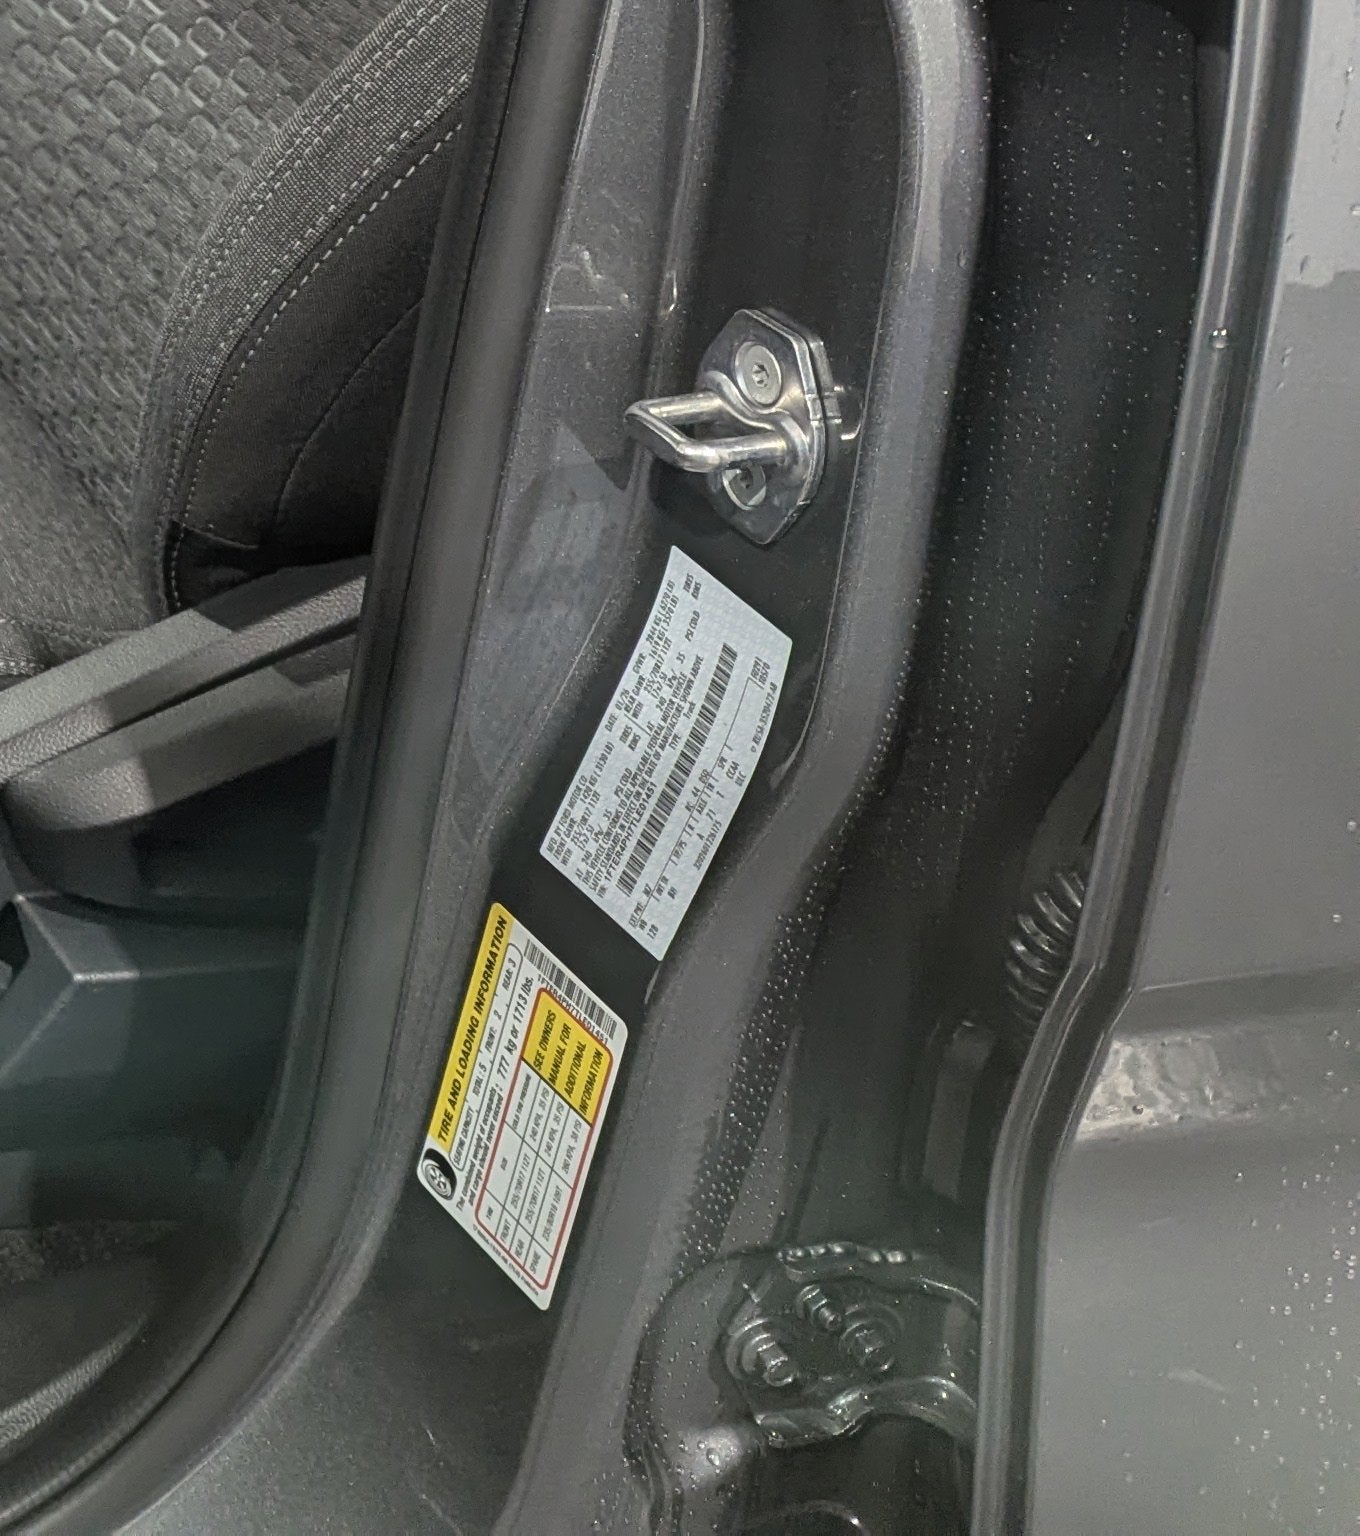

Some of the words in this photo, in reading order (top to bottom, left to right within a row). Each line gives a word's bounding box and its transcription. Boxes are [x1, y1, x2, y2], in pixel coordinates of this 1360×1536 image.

[669, 669, 687, 700] VEHICLE
[659, 697, 676, 725] MOTOR
[645, 720, 664, 753] FEDERAL
[628, 748, 651, 789] APPLICABLE
[588, 867, 604, 893] SAFETY
[599, 828, 622, 871] STANDARDS
[621, 798, 637, 825] EFFECT
[637, 775, 649, 792] THE
[644, 758, 657, 779] DATE
[657, 700, 684, 753] MANUFACTURE
[678, 675, 696, 705] SHOWN
[622, 785, 633, 801] ALL
[558, 806, 571, 828] FORD
[566, 785, 581, 810] MOTOR
[617, 797, 628, 811] TO
[600, 806, 623, 847] CONFORMS
[603, 779, 657, 883] 1FTER4PH7TLE01451
[553, 836, 567, 861] FRONT
[580, 848, 593, 866] 240
[588, 842, 606, 872] VEHICLE
[581, 868, 593, 887] THIS
[507, 956, 516, 968] 3
[492, 1008, 501, 1021] 2
[511, 991, 528, 1025] 1713
[437, 1107, 454, 1145] TIRE
[446, 1076, 462, 1111] AND
[454, 1013, 480, 1080] LOADING
[472, 913, 507, 1016] INFORMATION
[509, 1022, 519, 1040] or
[537, 1007, 556, 1052] OWNERS
[503, 1035, 517, 1058] kg
[532, 1048, 545, 1072] SEE
[547, 1042, 566, 1086] MANUAL
[558, 1021, 571, 1046] FOR
[478, 1060, 486, 1073] 5
[496, 1053, 510, 1081] 777
[563, 1037, 587, 1099] ADDITIONAL
[577, 1046, 604, 1116] INFORMATION
[480, 1085, 498, 1128] occupants
[490, 1092, 503, 1122] exceed
[452, 1134, 466, 1166] SEATING
[459, 1104, 474, 1140] CAPACITY
[478, 1123, 486, 1136] of
[485, 1120, 496, 1145] never
[470, 1133, 484, 1162] weight
[477, 1140, 490, 1170] should
[459, 1158, 476, 1198] combined
[471, 1166, 484, 1194] cargo
[455, 1194, 465, 1212] The
[467, 1188, 476, 1207] and
[513, 1236, 524, 1259] REAR
